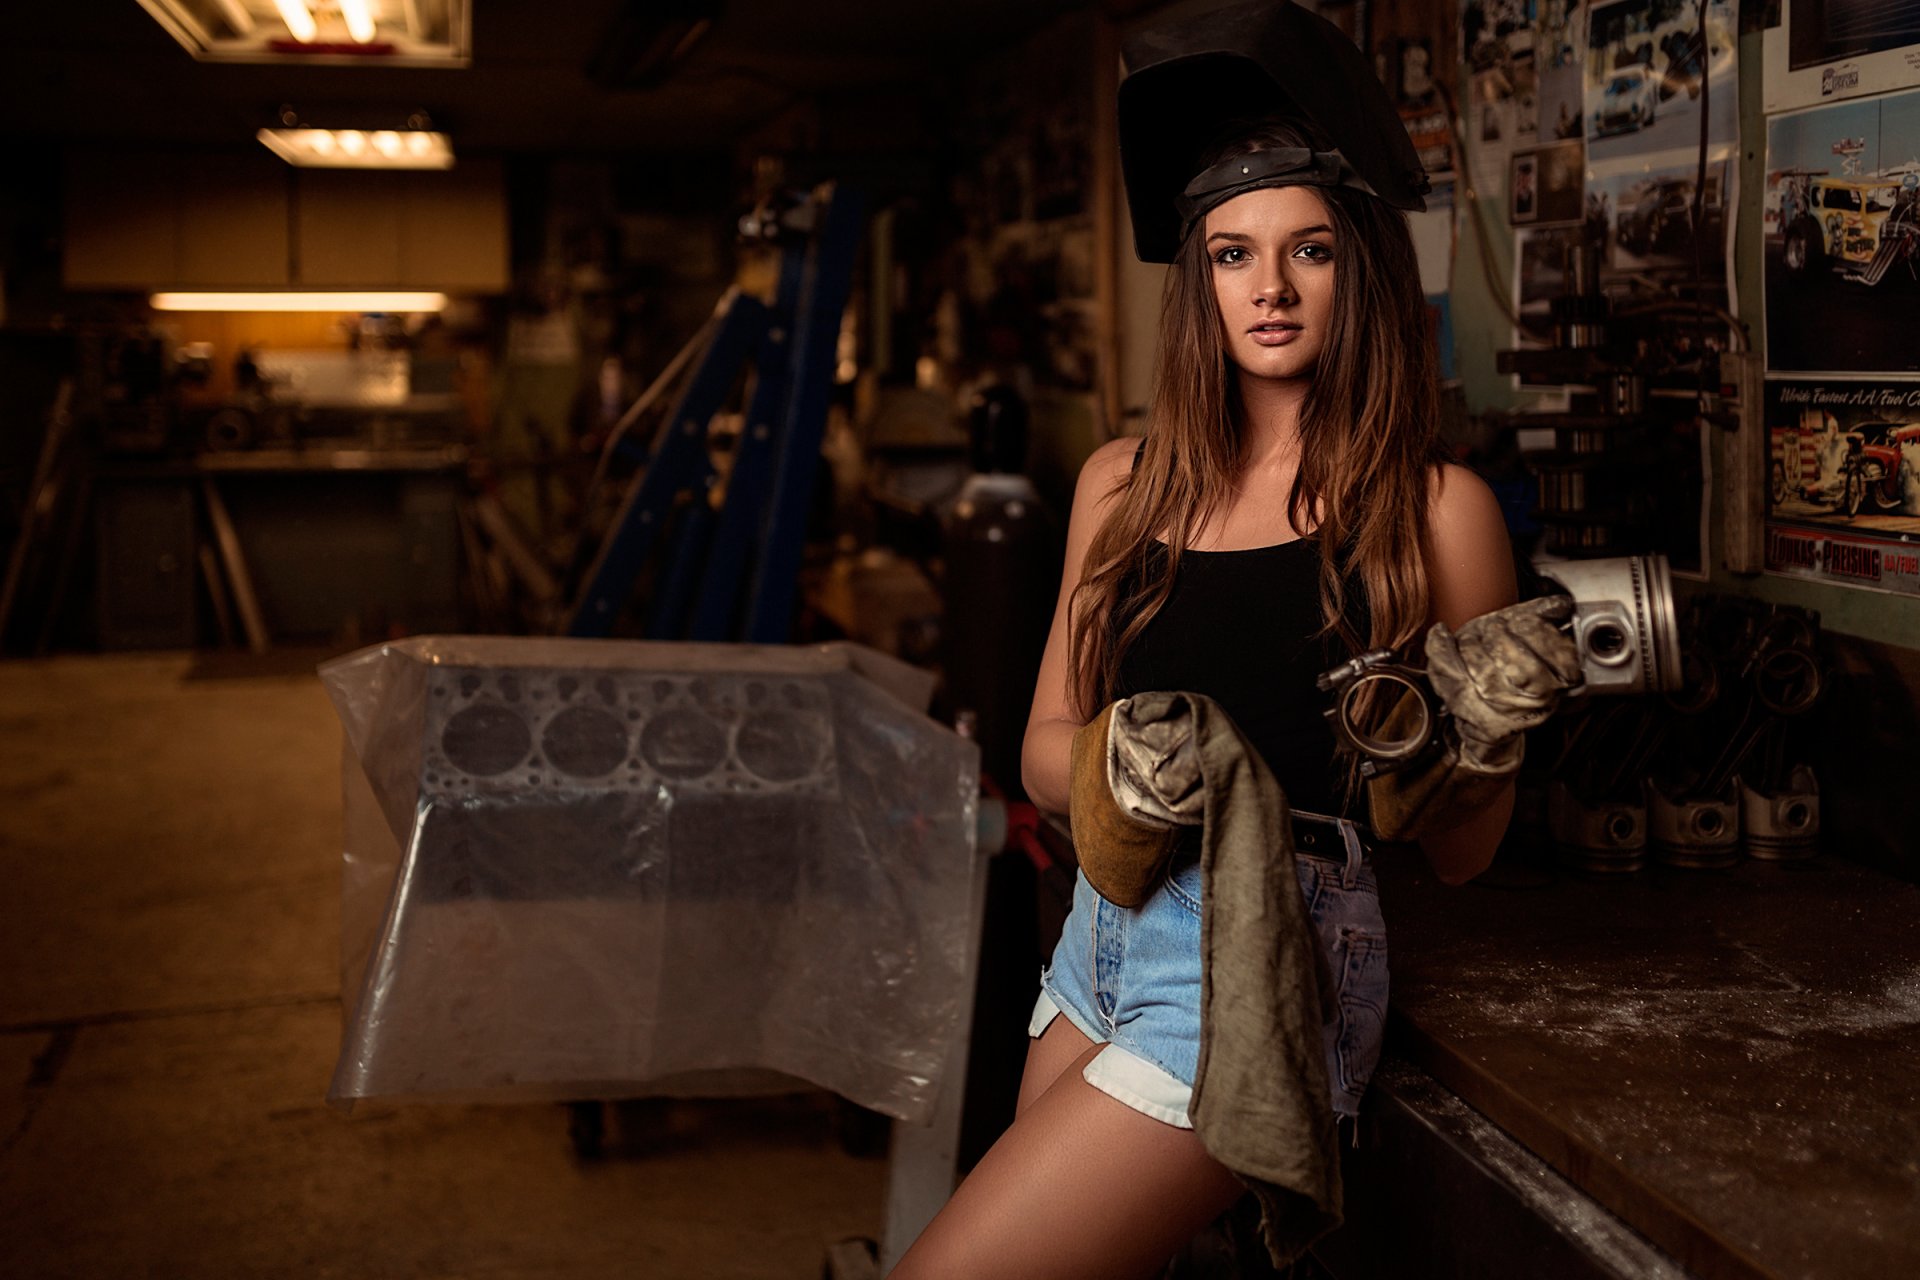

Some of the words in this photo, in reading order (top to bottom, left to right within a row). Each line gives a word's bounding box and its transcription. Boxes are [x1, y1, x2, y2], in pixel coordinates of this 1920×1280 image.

[1770, 531, 1815, 566] LOUKAS
[1822, 539, 1881, 580] PREISING
[1884, 553, 1920, 576] AA/FUEL
